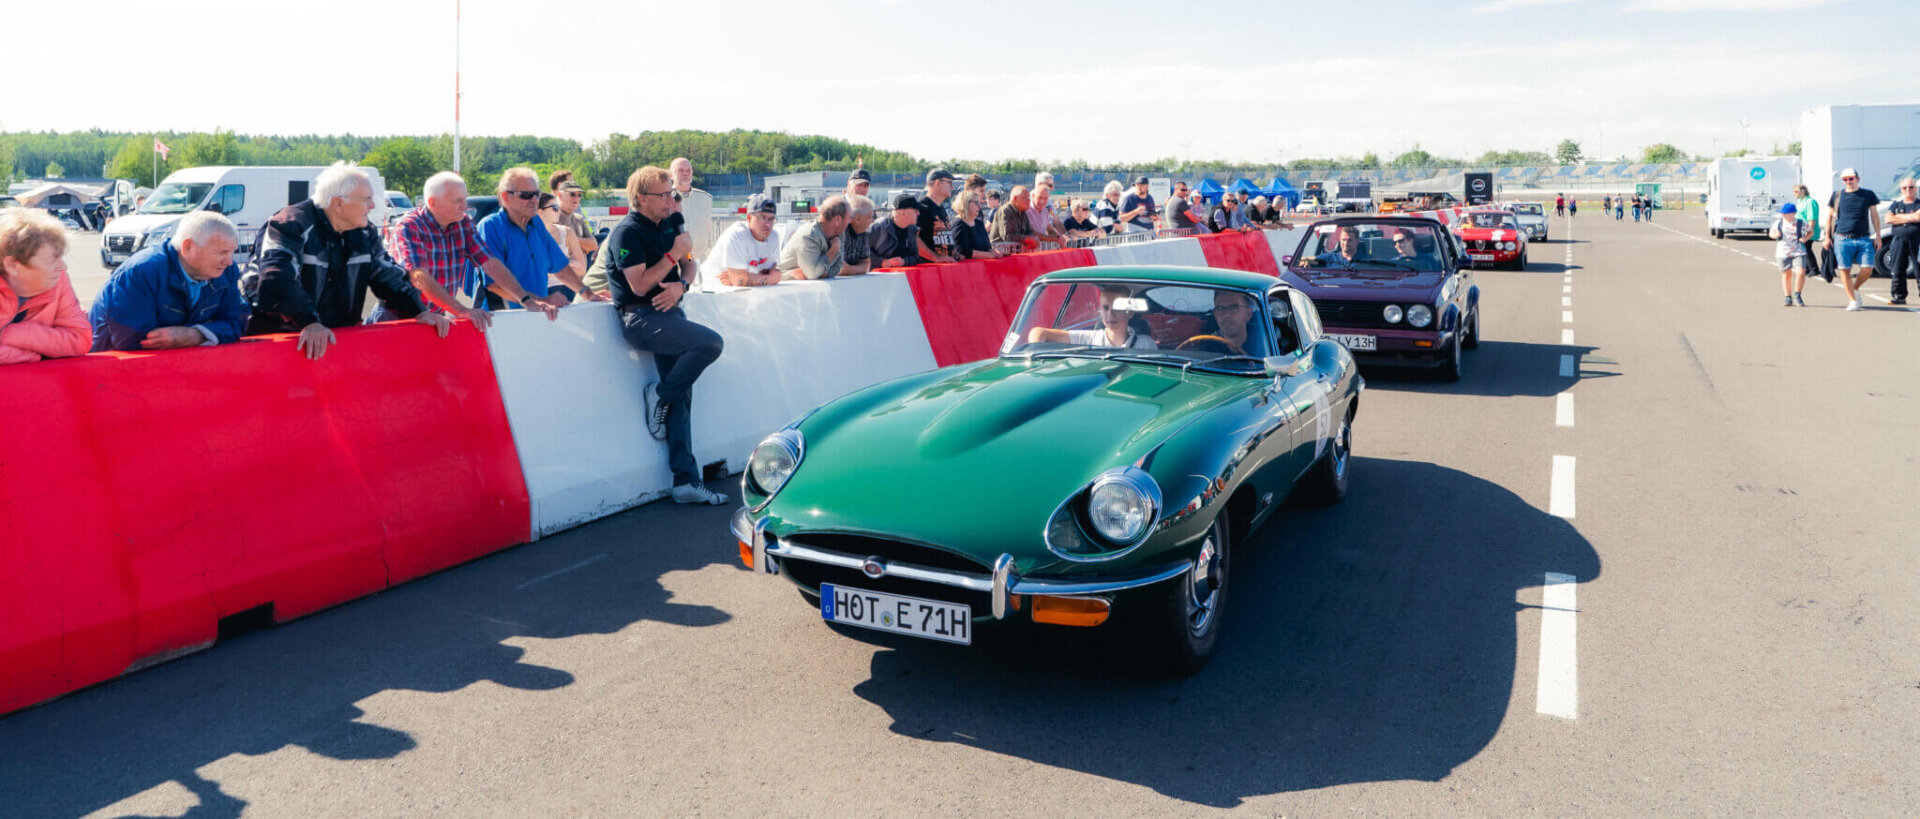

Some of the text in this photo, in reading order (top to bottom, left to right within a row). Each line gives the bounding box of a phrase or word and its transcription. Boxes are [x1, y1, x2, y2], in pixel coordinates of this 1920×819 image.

[834, 590, 967, 638] HOT E 71H
